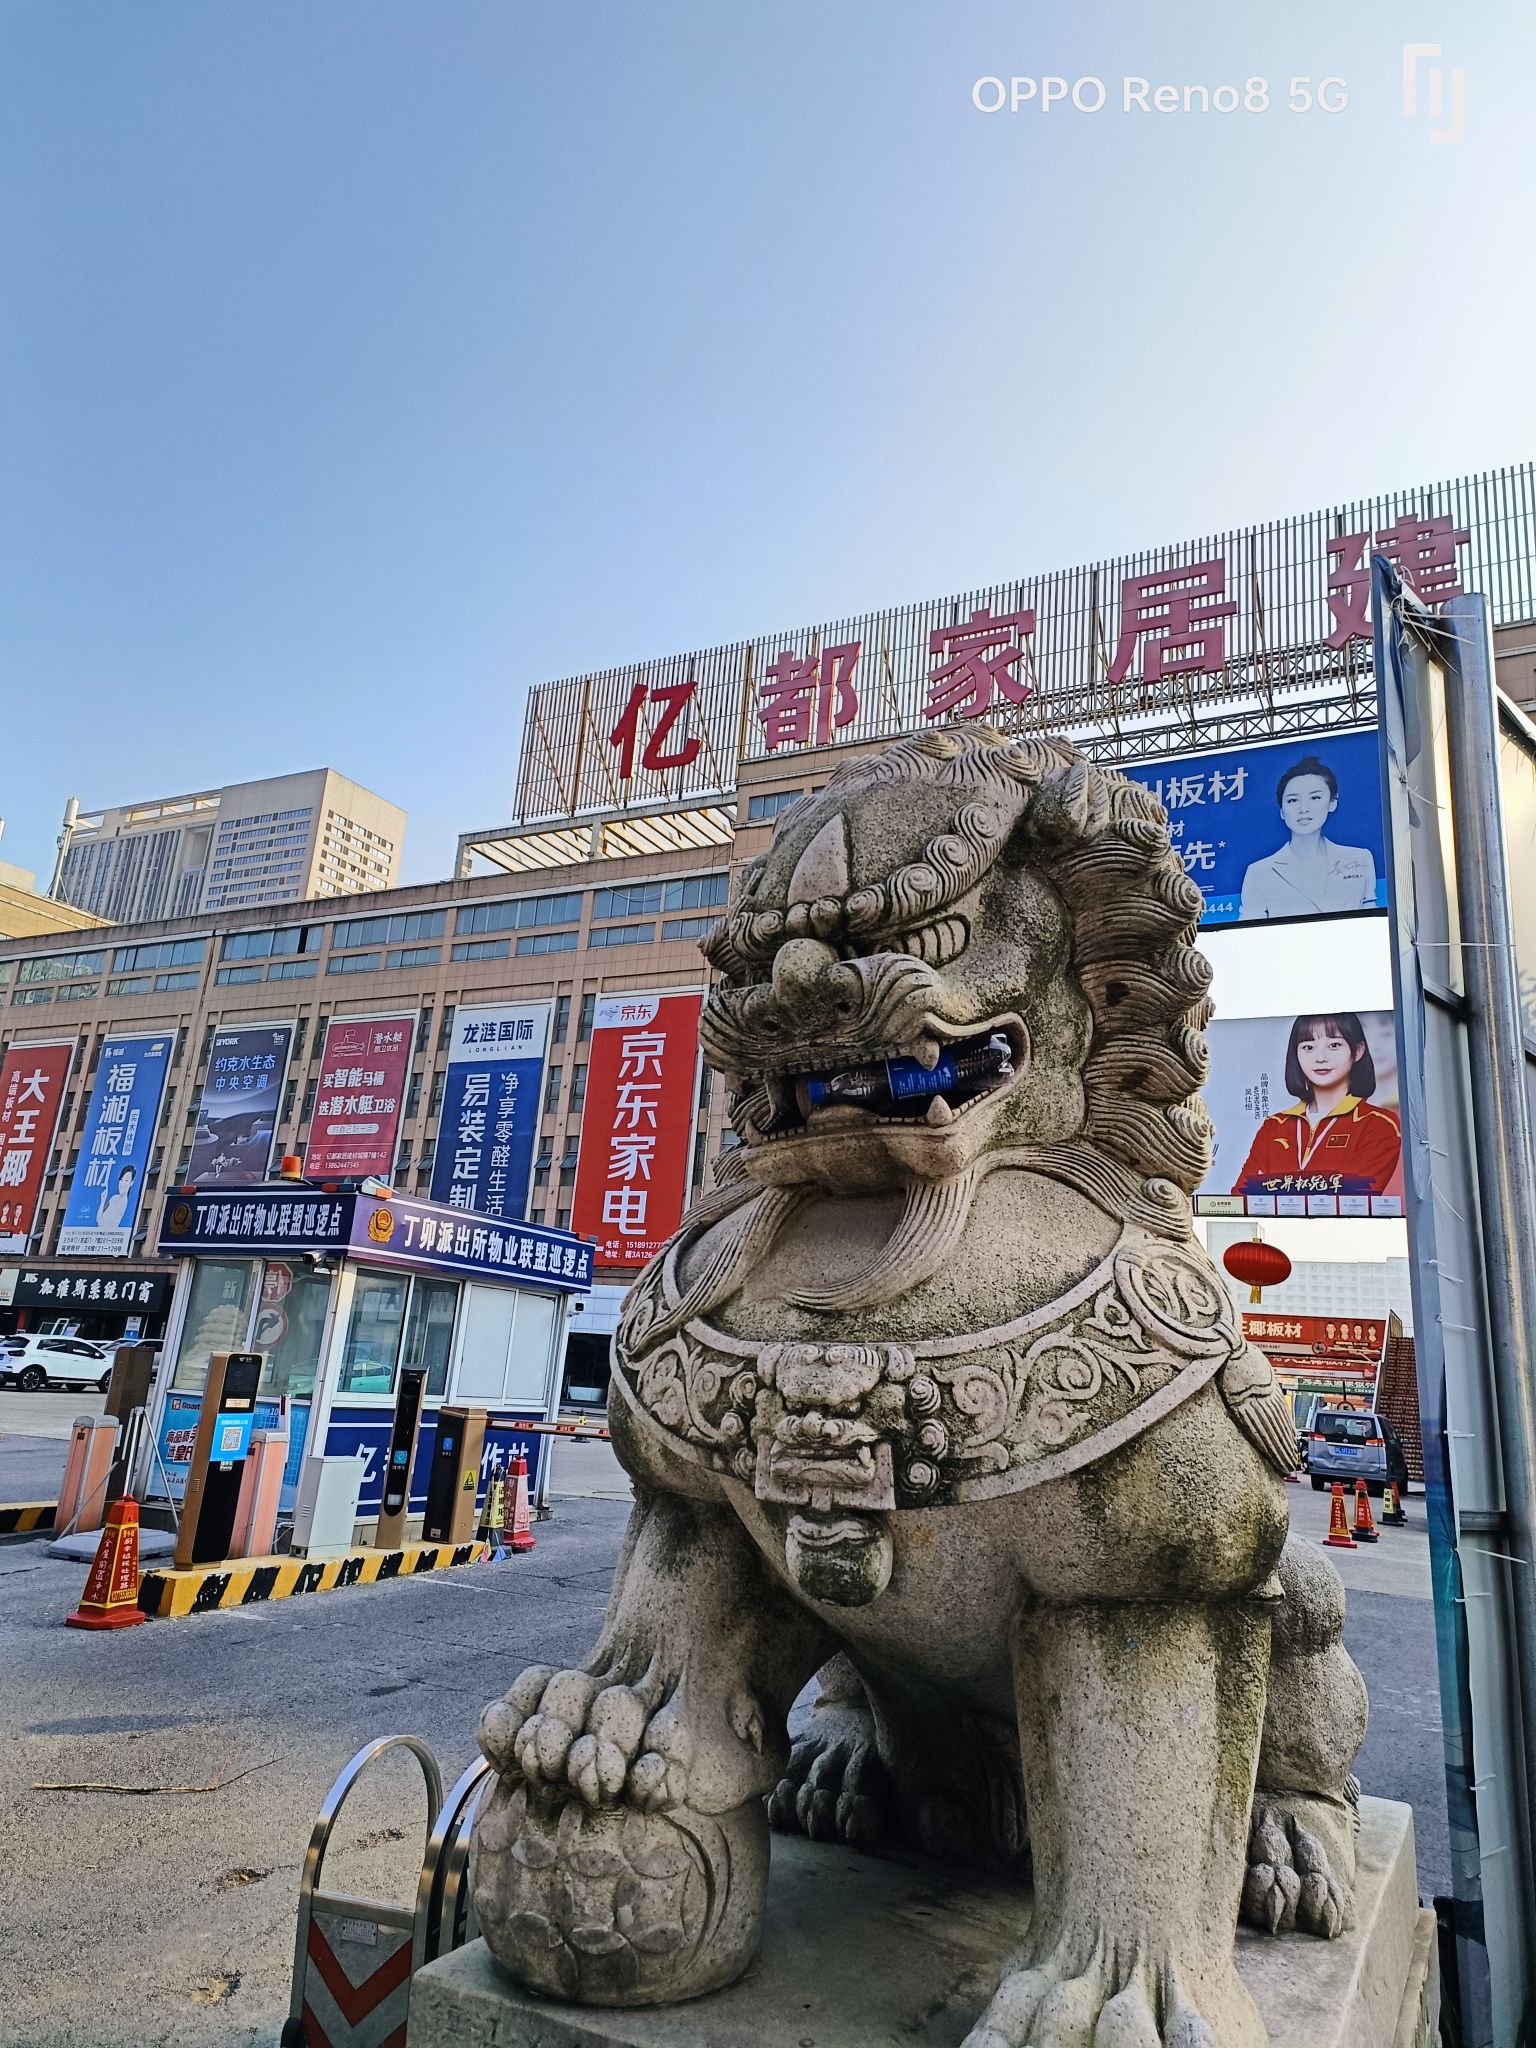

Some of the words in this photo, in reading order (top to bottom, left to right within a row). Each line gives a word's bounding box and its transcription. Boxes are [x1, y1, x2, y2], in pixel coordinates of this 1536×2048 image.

[1143, 767, 1249, 812] 板材
[620, 1004, 653, 1020] 京东
[374, 1031, 403, 1044] 潜水艇
[462, 1019, 534, 1045] 龙涟国际
[468, 1045, 523, 1053] LONGLIAN
[215, 1054, 276, 1072] 约克水生态
[215, 1074, 268, 1092] 中央空调
[323, 1067, 385, 1089] 买智能马桶
[2, 1070, 21, 1122] 高端板材
[318, 1094, 396, 1116] 选潜水艇卫浴
[0, 1069, 49, 1187] 大王椰
[83, 1063, 137, 1187] 福湘板材
[602, 1031, 667, 1235] 京东家电
[449, 1073, 491, 1212] 易装定制
[485, 1072, 519, 1217] 净享零醛生活
[1262, 1174, 1343, 1194] 世界杯冠军
[195, 1203, 344, 1237] 丁卯派出所物业联盟巡逻点
[403, 1214, 588, 1279] 丁卯派出所物业联盟巡逻点
[38, 1277, 155, 1303] 加维斯系统门窗
